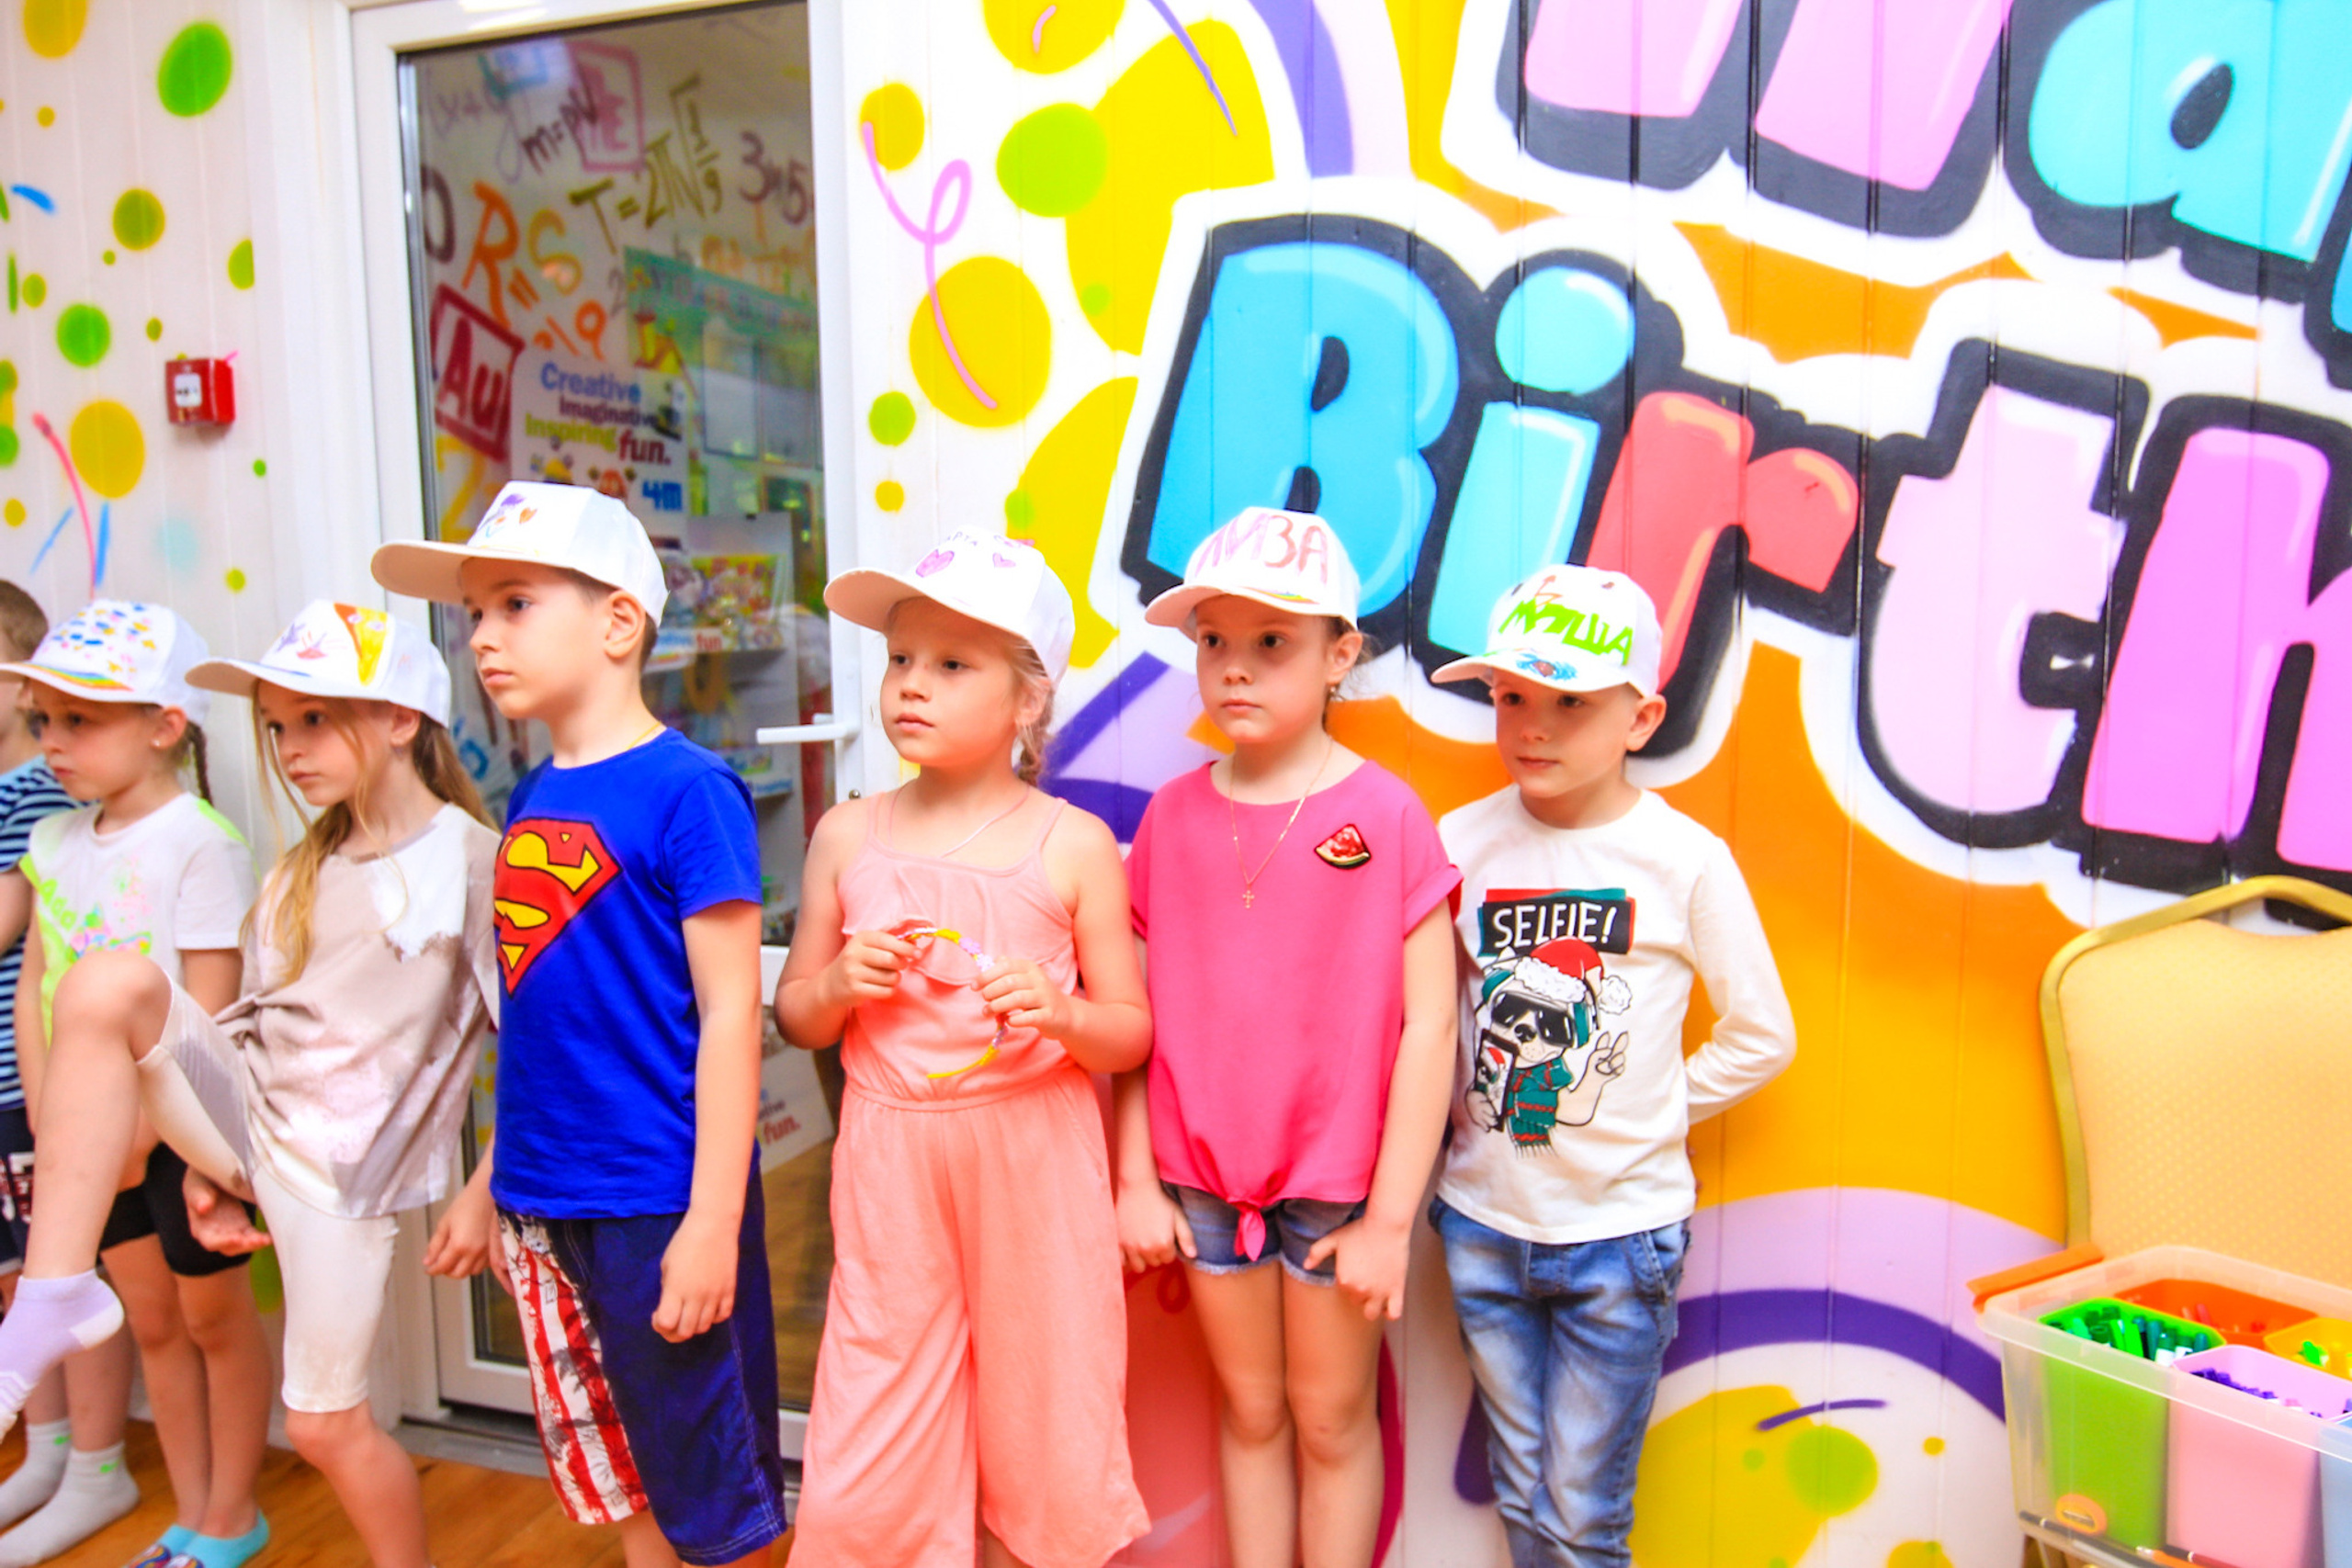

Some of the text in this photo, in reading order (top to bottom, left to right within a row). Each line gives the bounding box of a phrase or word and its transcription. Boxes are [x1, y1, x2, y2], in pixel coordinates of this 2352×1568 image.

[540, 361, 641, 404] Creative
[618, 428, 672, 465] fun.
[1493, 901, 1618, 950] SELFIE!
